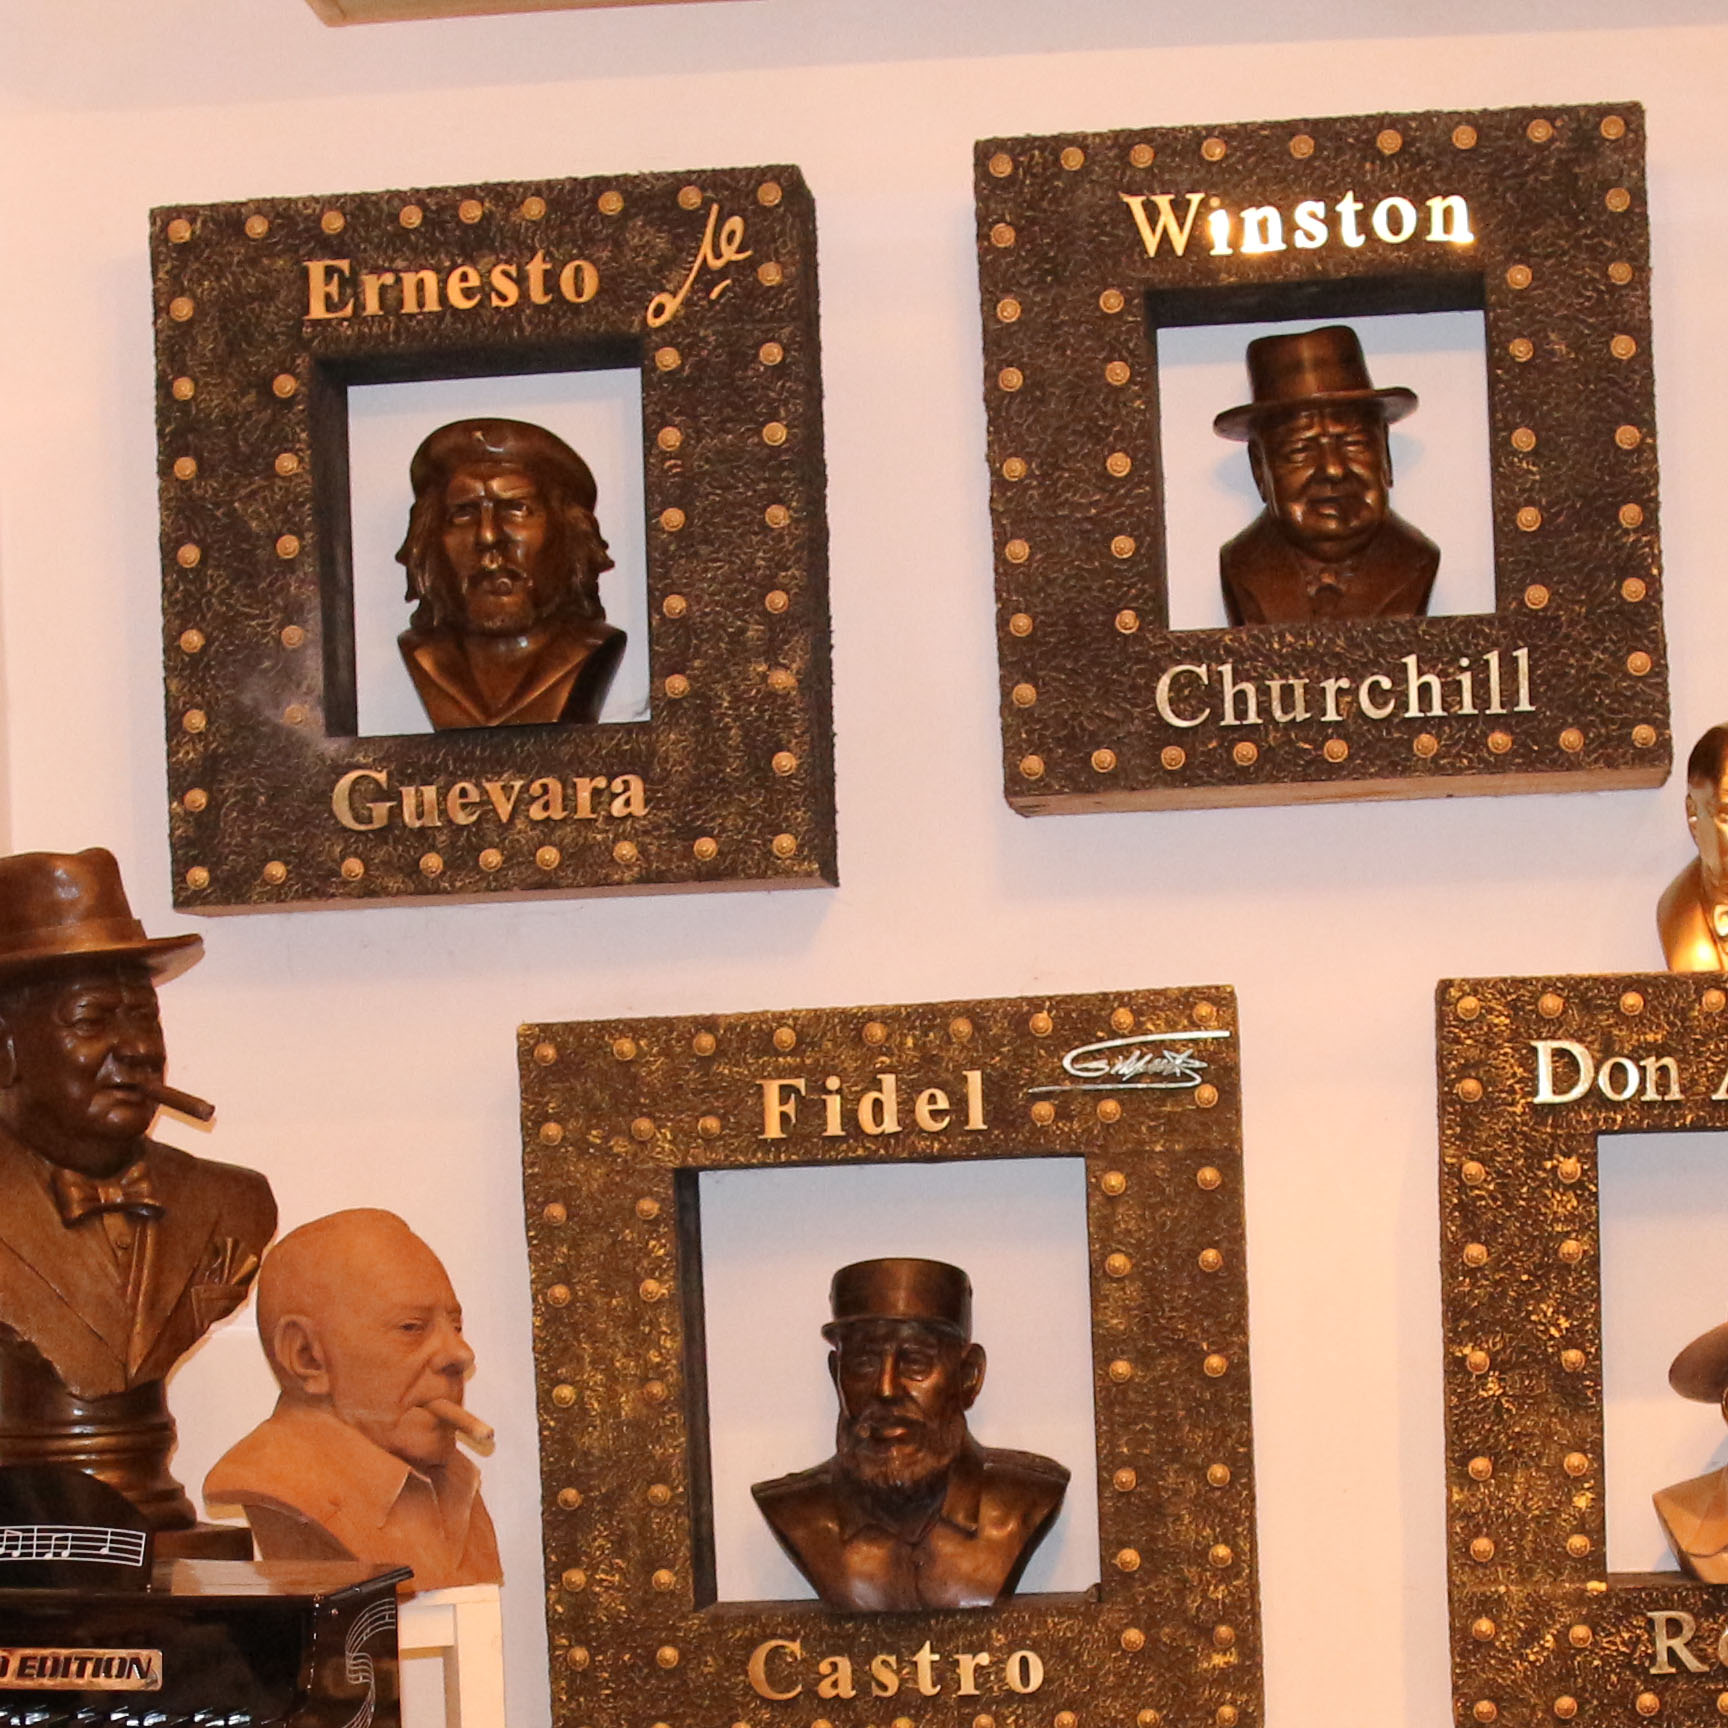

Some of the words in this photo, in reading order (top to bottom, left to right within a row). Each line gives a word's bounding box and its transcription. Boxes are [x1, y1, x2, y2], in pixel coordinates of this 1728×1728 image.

[1119, 191, 1476, 259] Winston
[303, 250, 600, 321] Ernesto
[1155, 647, 1537, 728] Churchill
[332, 769, 650, 832] Guevara
[756, 1071, 989, 1140] Fidel
[1530, 1038, 1684, 1106] Don
[16, 1655, 153, 1681] EDITION
[747, 1639, 1046, 1701] Castro
